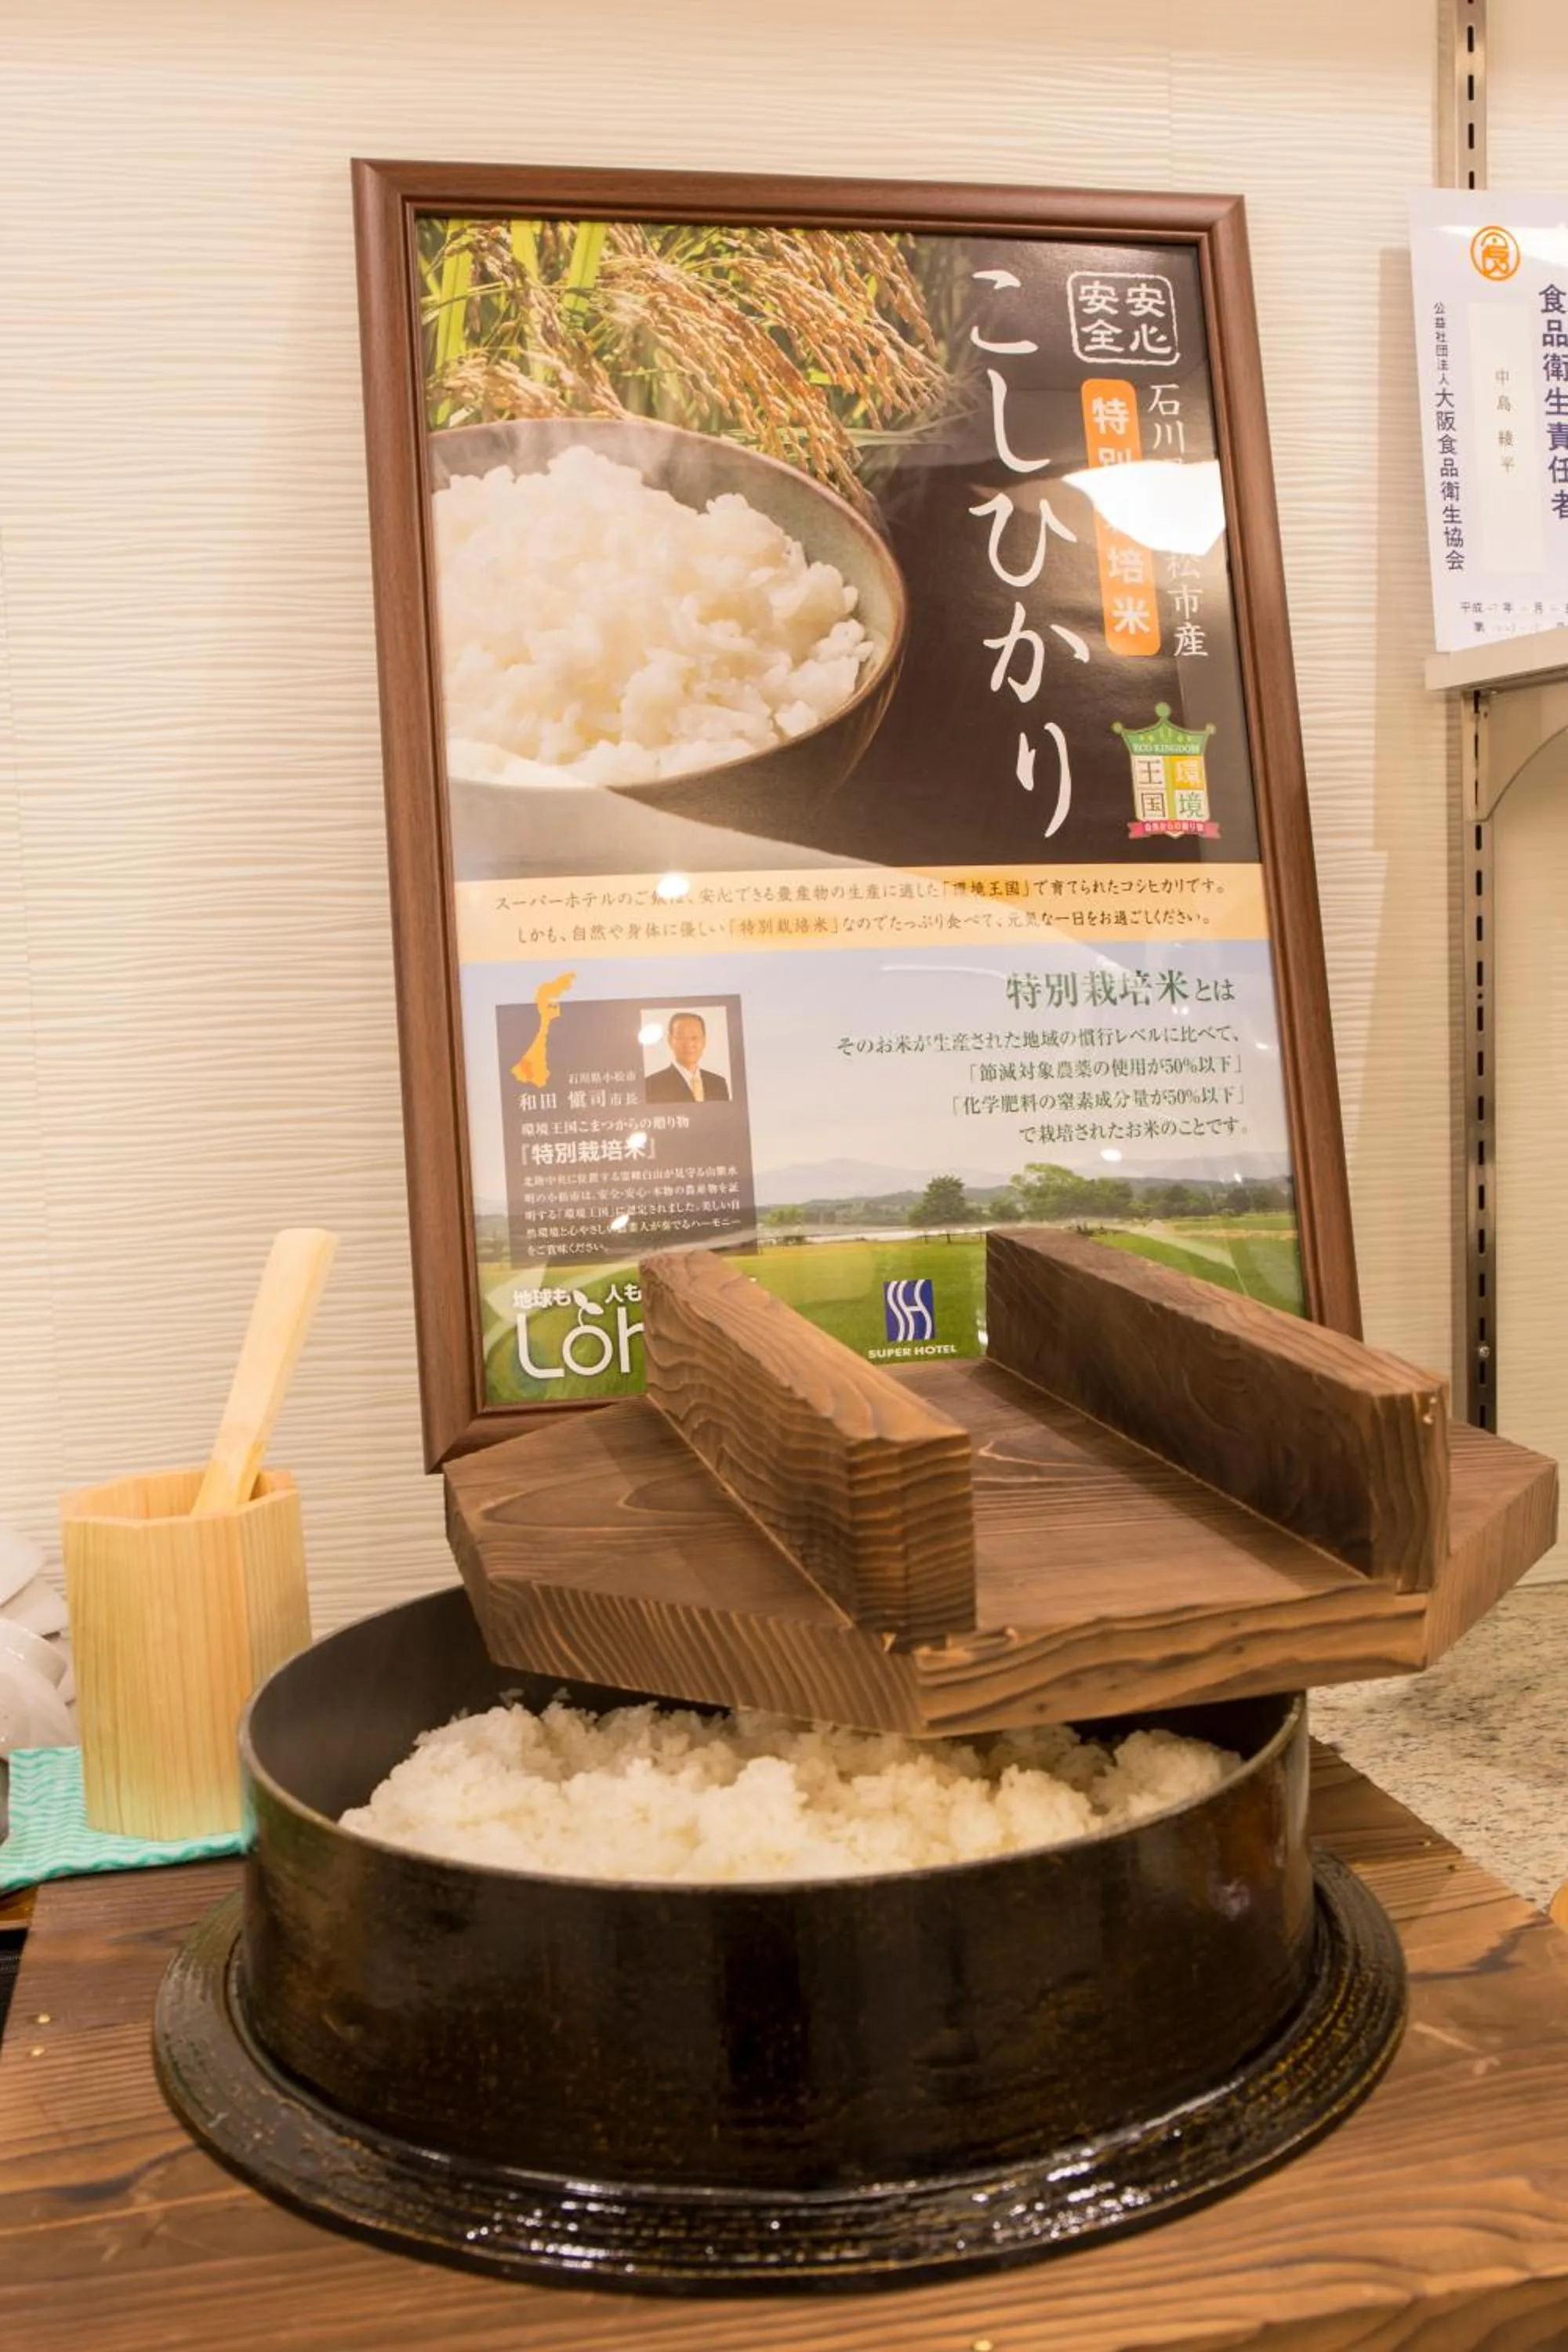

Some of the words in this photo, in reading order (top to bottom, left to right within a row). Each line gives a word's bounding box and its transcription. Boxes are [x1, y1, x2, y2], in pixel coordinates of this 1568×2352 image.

[969, 270, 1091, 838] こしひかり
[1091, 396, 1151, 636] 特別培米
[1148, 383, 1209, 657] 石川松市産
[1006, 969, 1236, 1009] 特別栽培米とは
[513, 1289, 572, 1308] 地球も
[868, 1347, 912, 1359] SUPER
[914, 1345, 957, 1356] HOTEL
